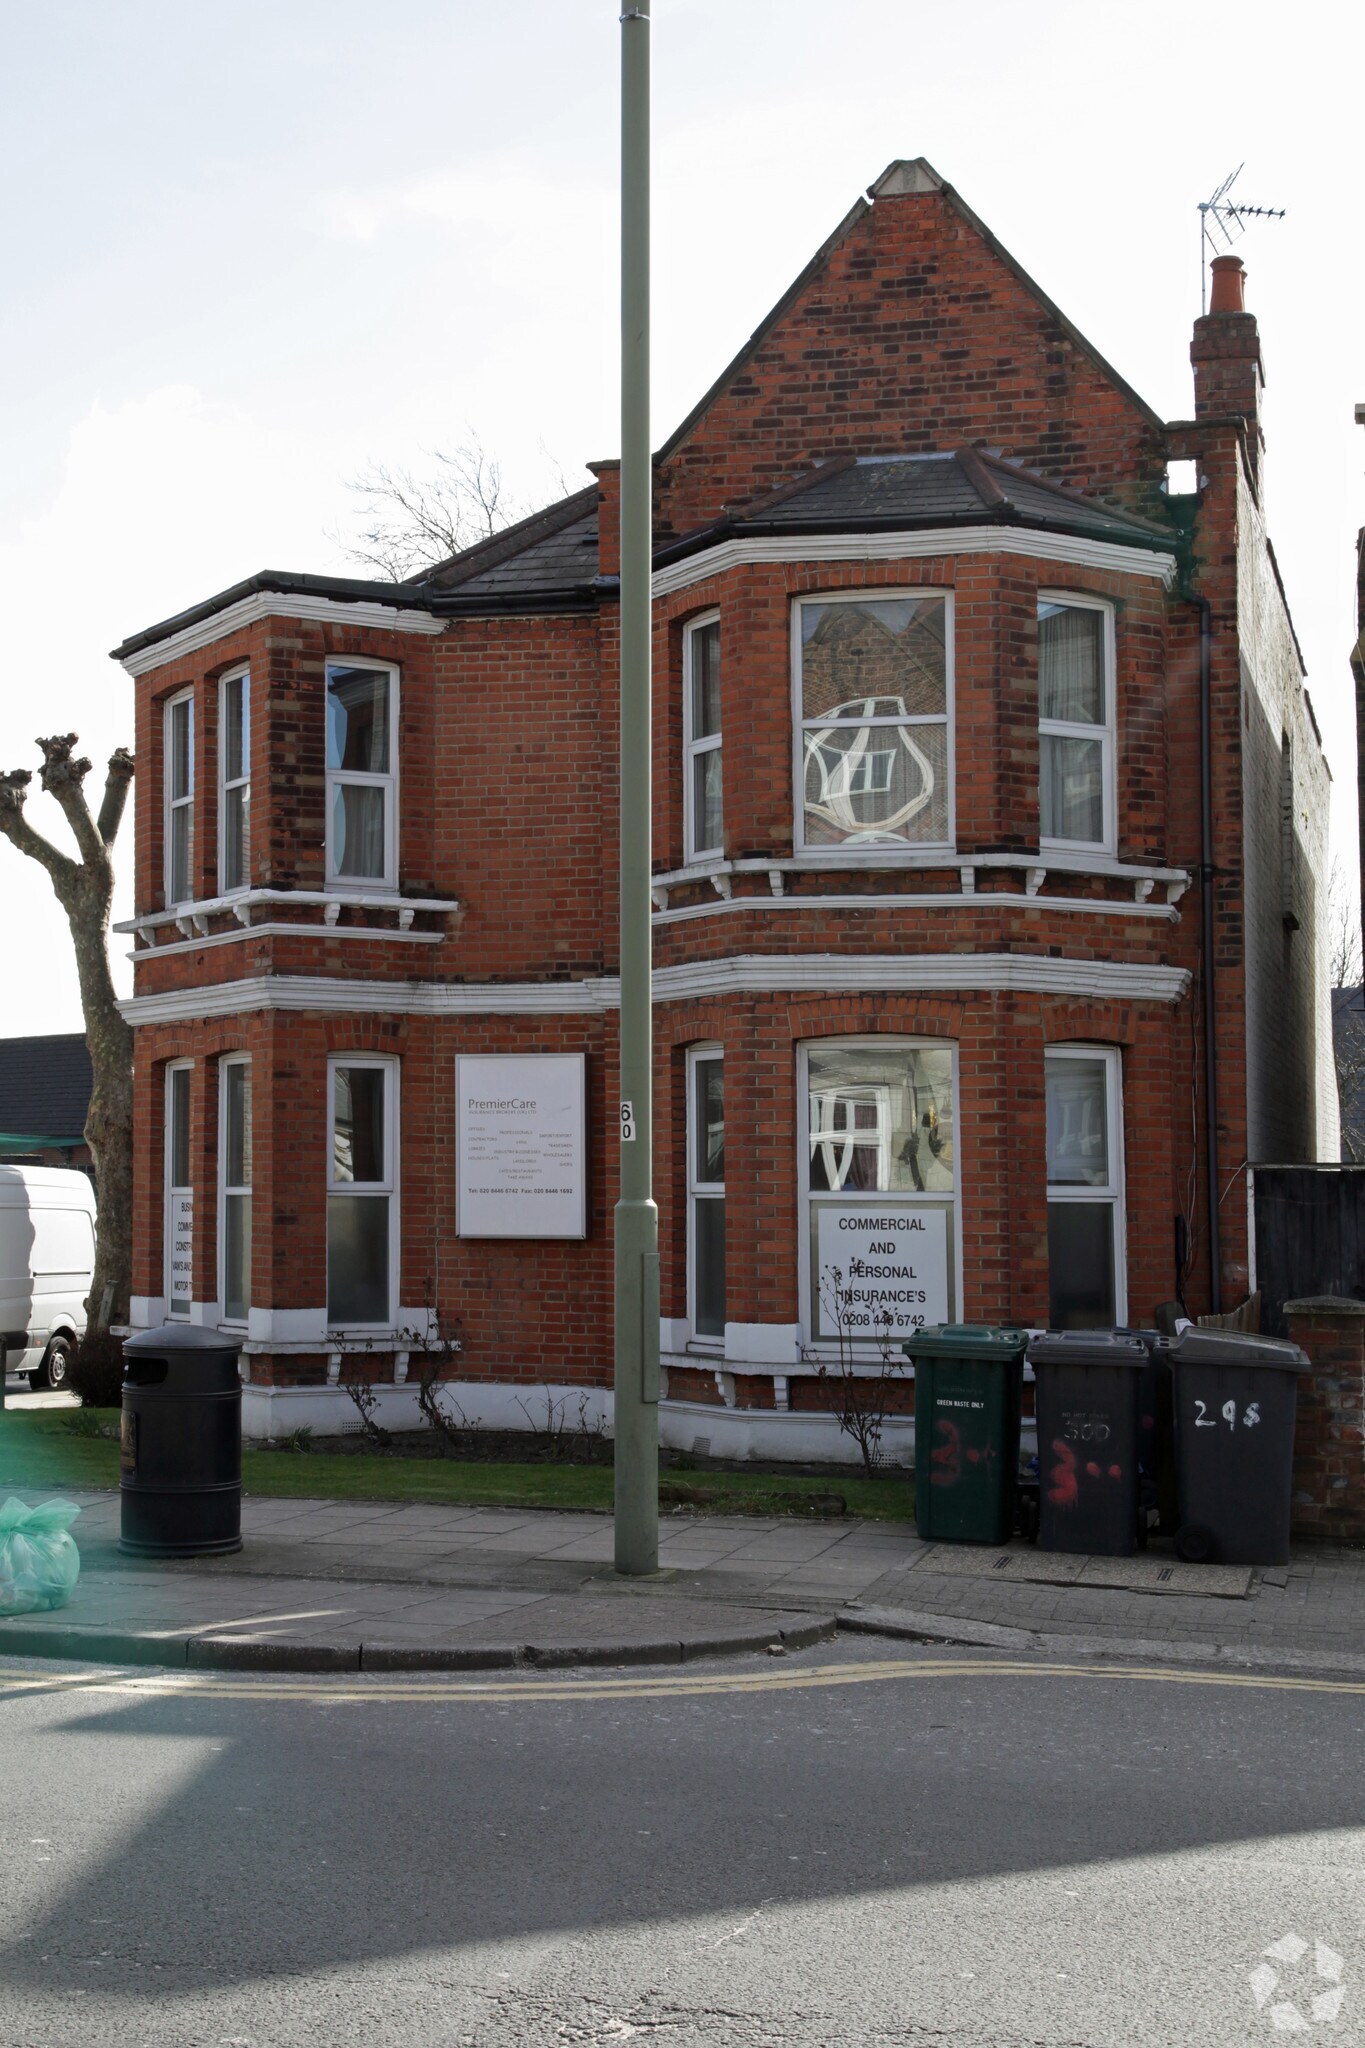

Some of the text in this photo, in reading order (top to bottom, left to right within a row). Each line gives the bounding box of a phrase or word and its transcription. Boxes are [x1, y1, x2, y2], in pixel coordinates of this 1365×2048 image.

[468, 1098, 536, 1109] PremierCare
[839, 1218, 926, 1230] COMMERCIAL
[869, 1242, 896, 1254] AND
[849, 1266, 917, 1278] PERSONAL
[841, 1290, 926, 1303] INSURANCE'S
[843, 1314, 925, 1326] 0208 446 6742
[953, 1400, 970, 1408] WASTE
[971, 1401, 984, 1409] ONLY
